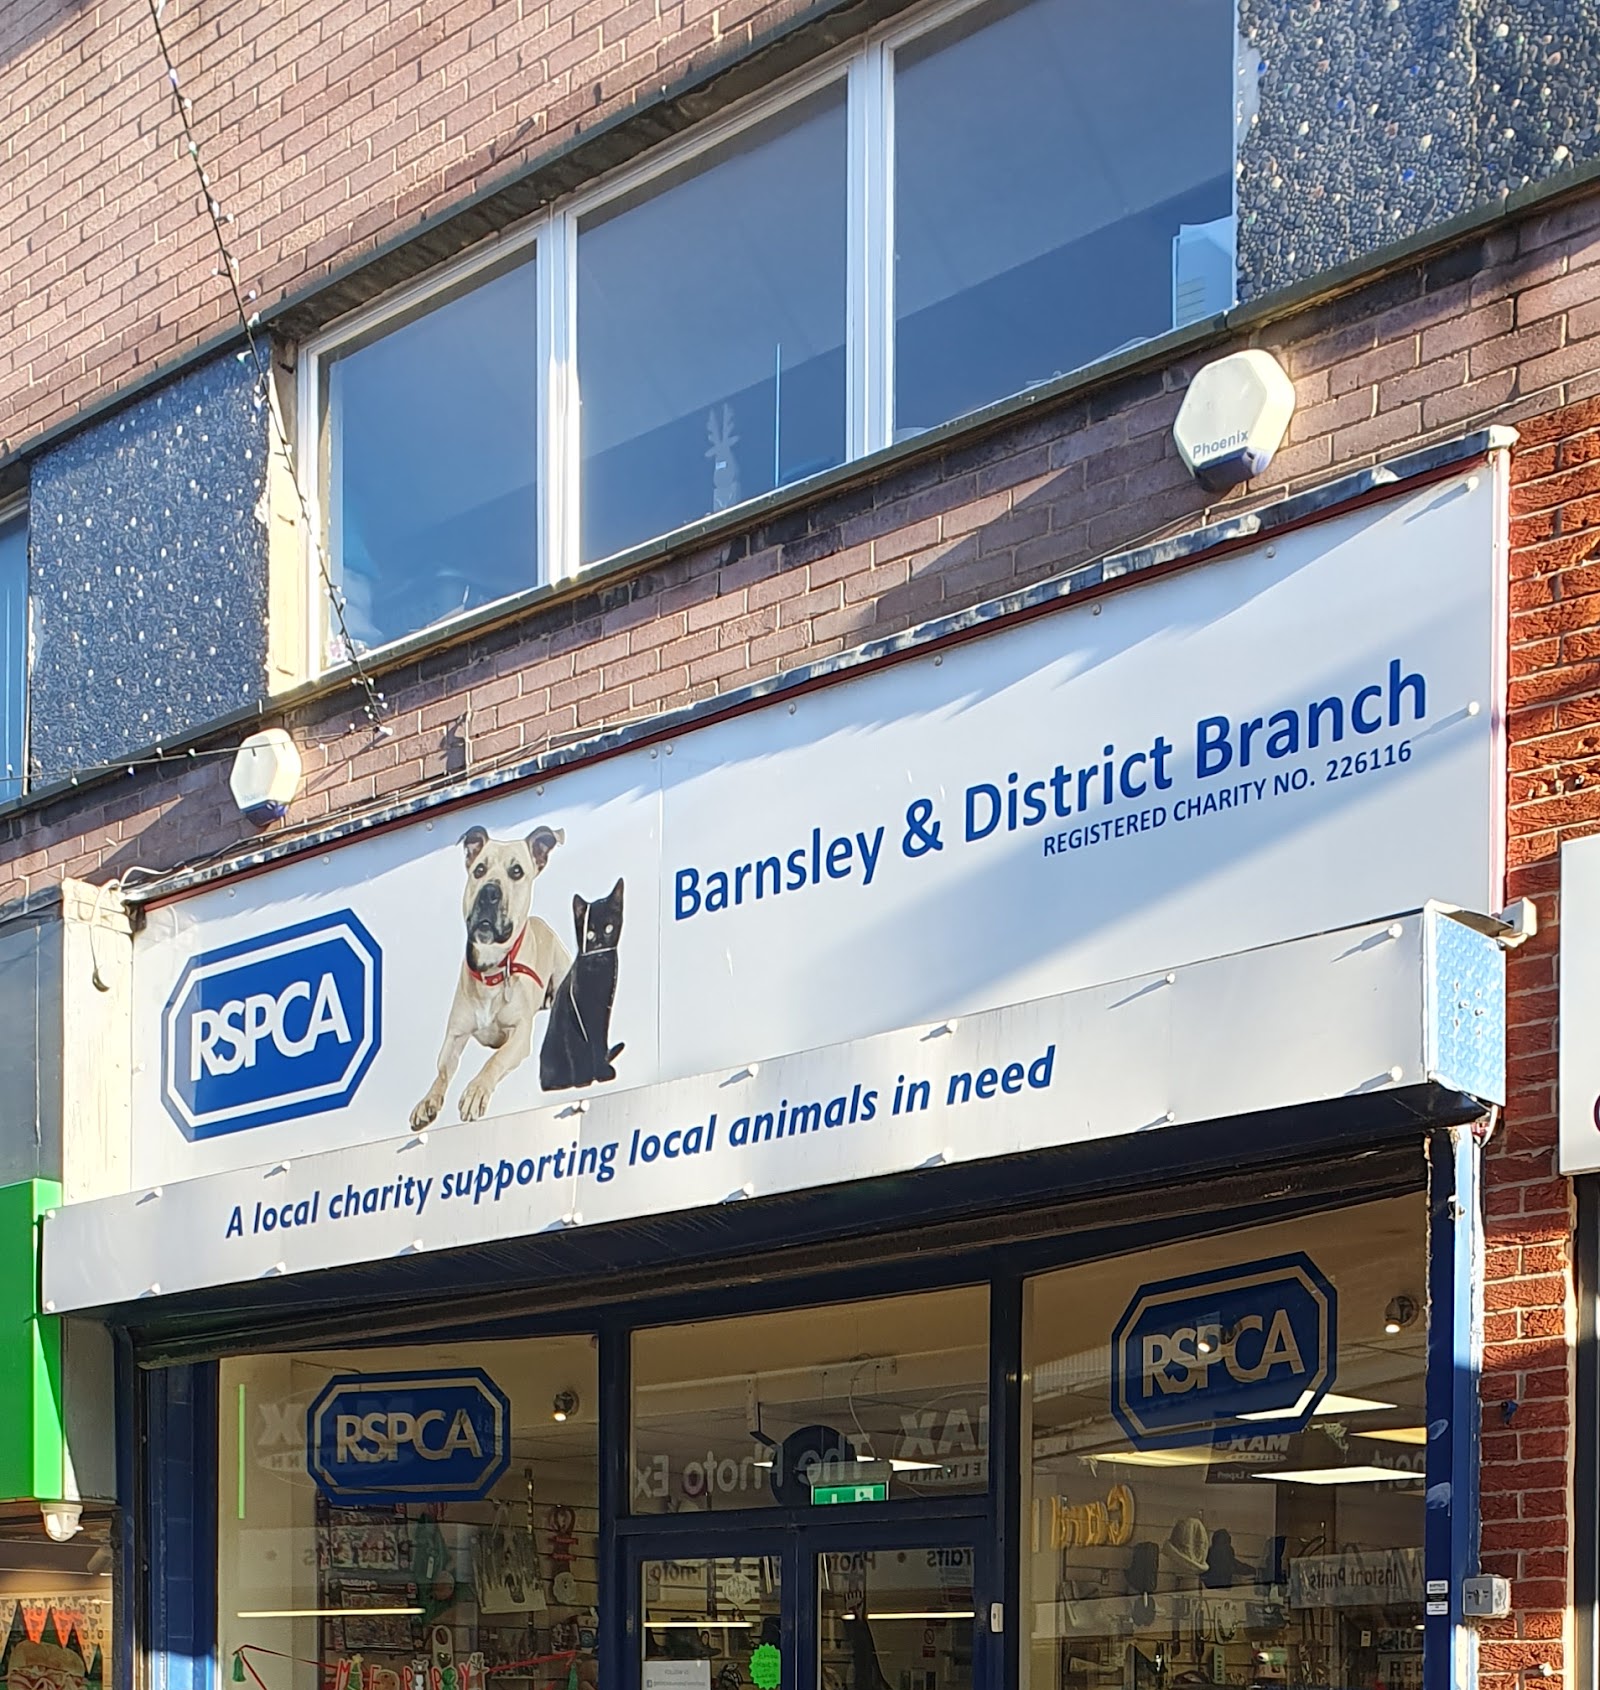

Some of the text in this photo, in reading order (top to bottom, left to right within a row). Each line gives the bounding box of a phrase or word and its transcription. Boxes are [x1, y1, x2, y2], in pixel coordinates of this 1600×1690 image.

[1192, 430, 1249, 459] Phoenix
[675, 658, 1426, 921] Barnsley & District Branch
[1043, 739, 1413, 857] REGISTERED CHARITY NO. 226116
[190, 972, 352, 1082] RSPCA
[225, 1045, 1057, 1239] A local charity supporting local animals in need
[1142, 1308, 1306, 1398] RSPCA
[336, 1408, 484, 1463] RSPCA
